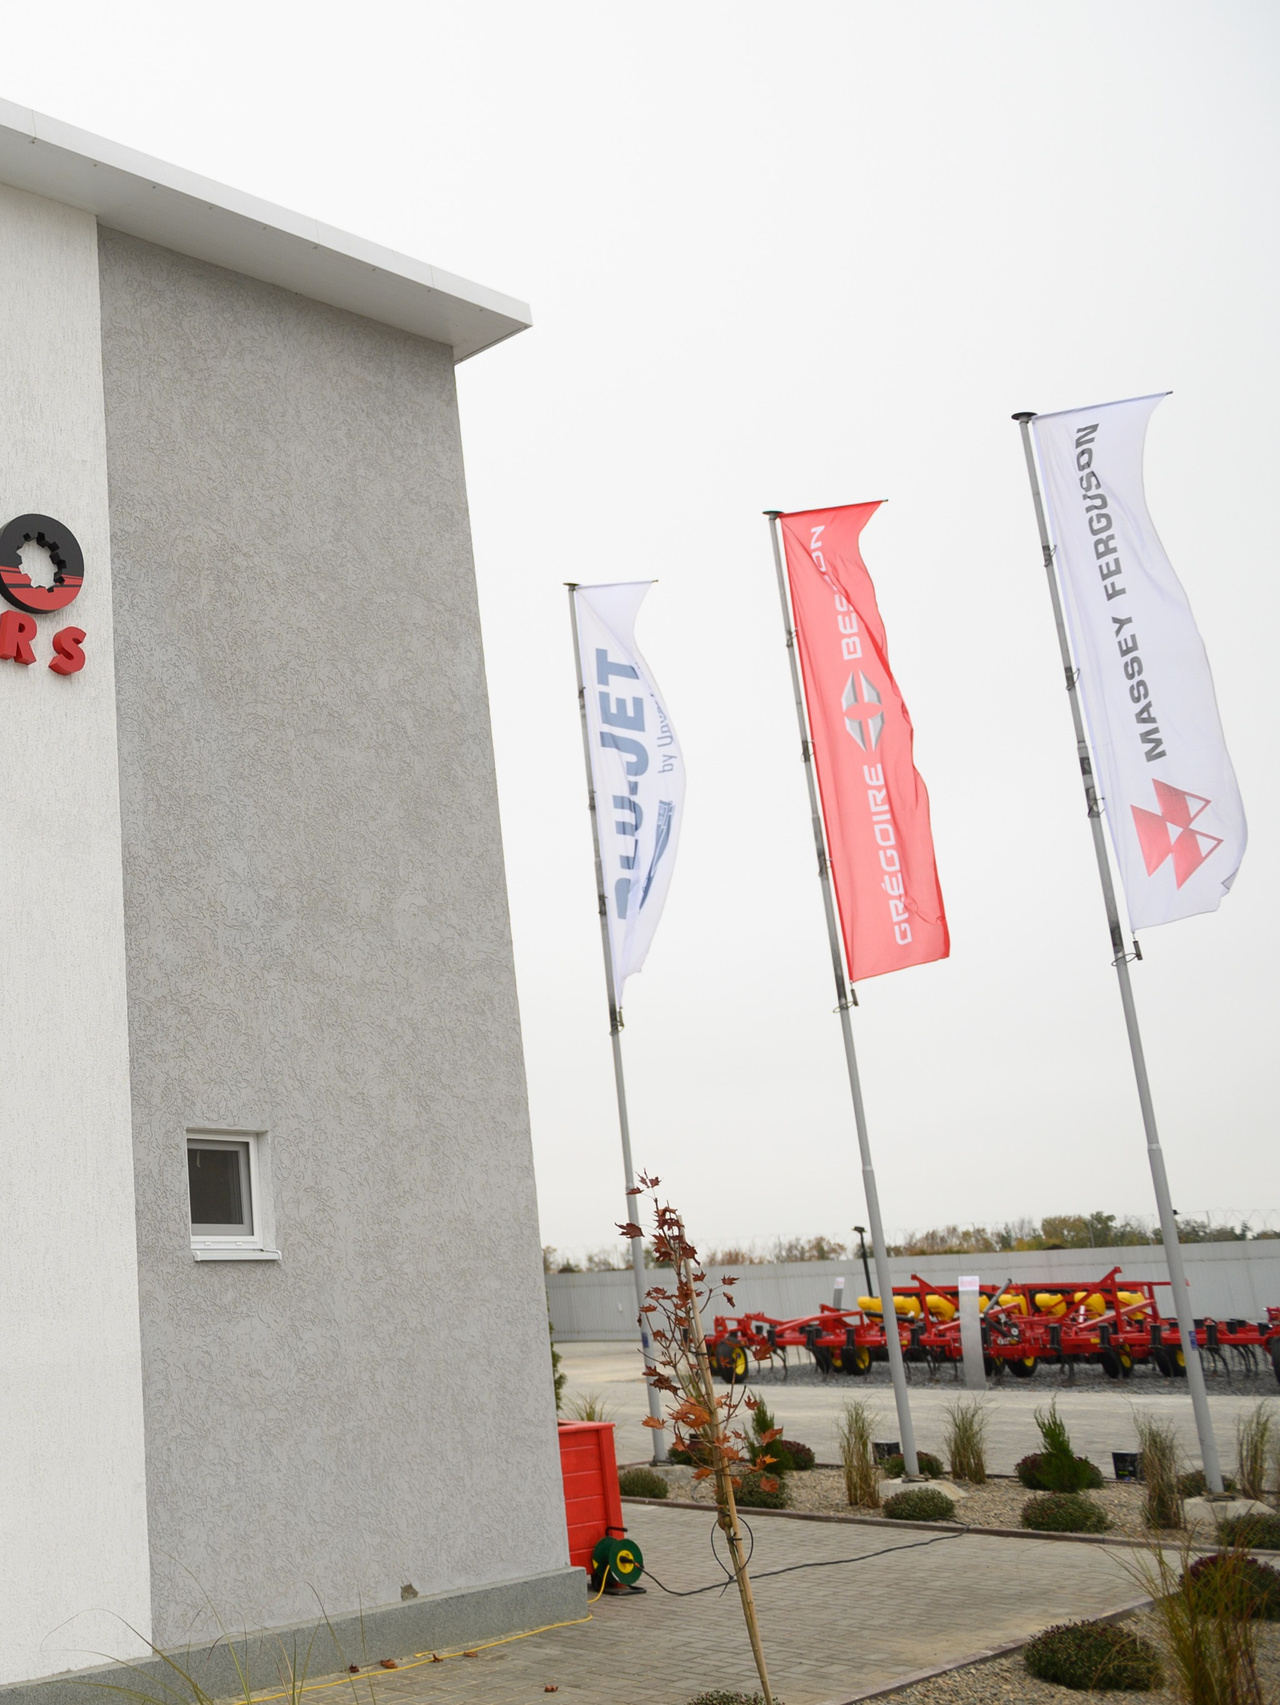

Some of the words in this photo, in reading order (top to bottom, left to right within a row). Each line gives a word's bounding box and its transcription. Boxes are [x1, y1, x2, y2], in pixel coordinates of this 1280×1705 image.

[1075, 423, 1127, 601] FERGUSON
[810, 525, 863, 661] BESON
[1111, 616, 1167, 763] MASSEY
[657, 754, 677, 774] by
[863, 763, 913, 946] GRÉGOIRE
